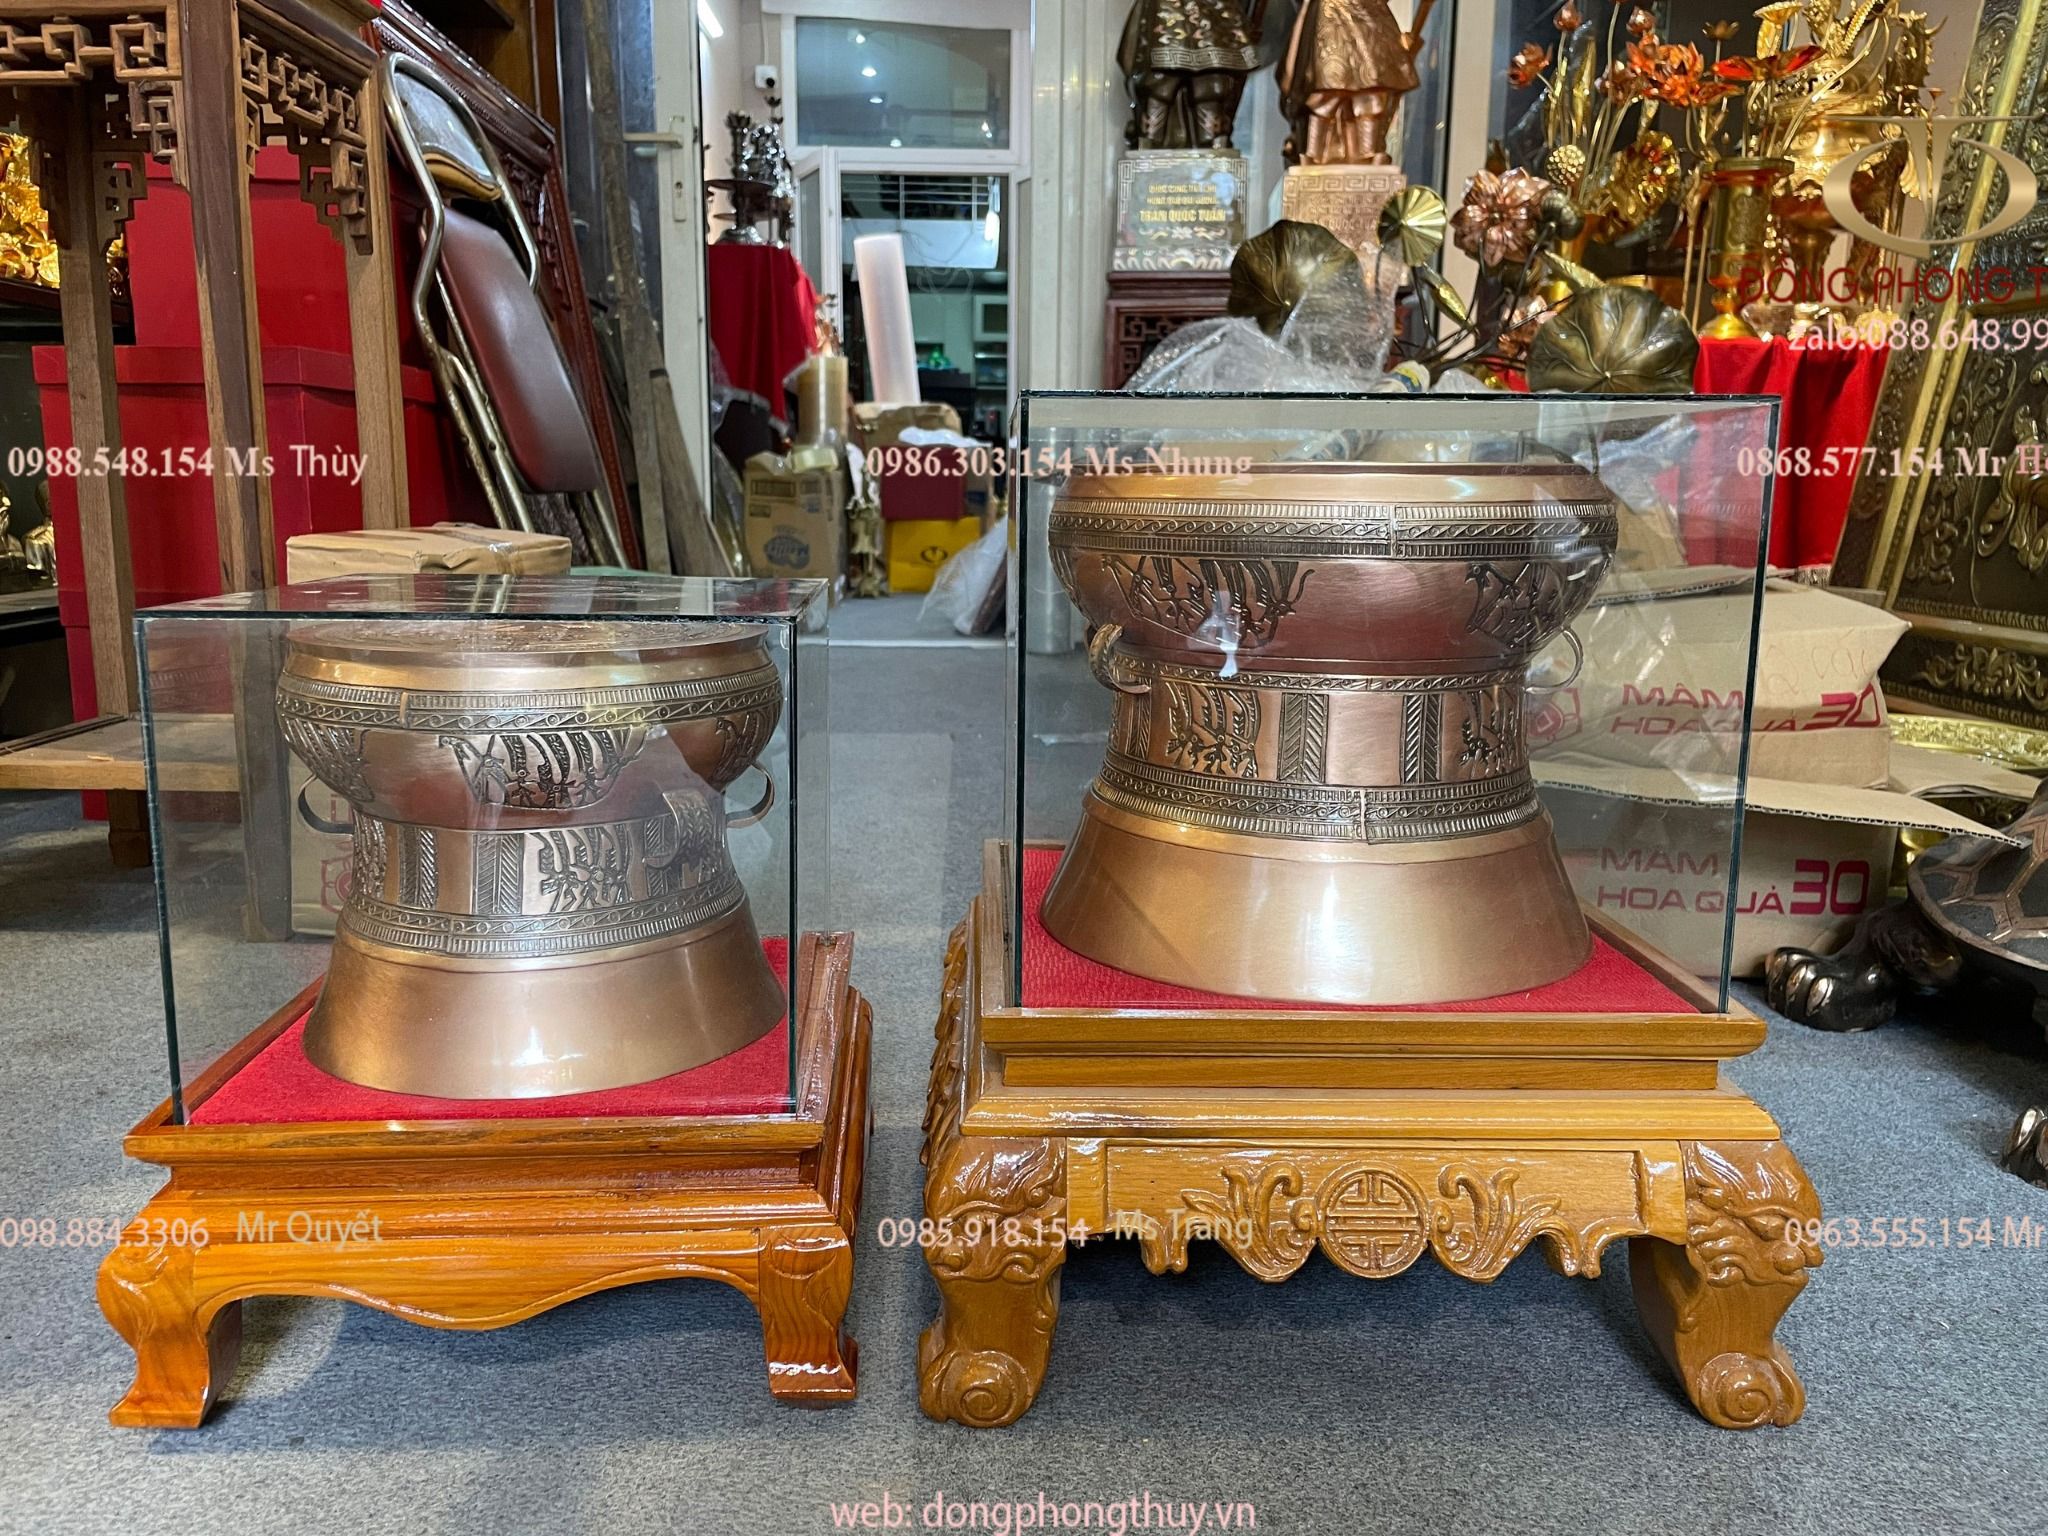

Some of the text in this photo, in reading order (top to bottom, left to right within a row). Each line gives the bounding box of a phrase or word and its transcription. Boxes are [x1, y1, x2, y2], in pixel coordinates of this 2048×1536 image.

[1610, 716, 1703, 735] HOA
[1801, 682, 1881, 729] 30
[1597, 885, 1687, 910] HOA
[1789, 858, 1870, 915] 30
